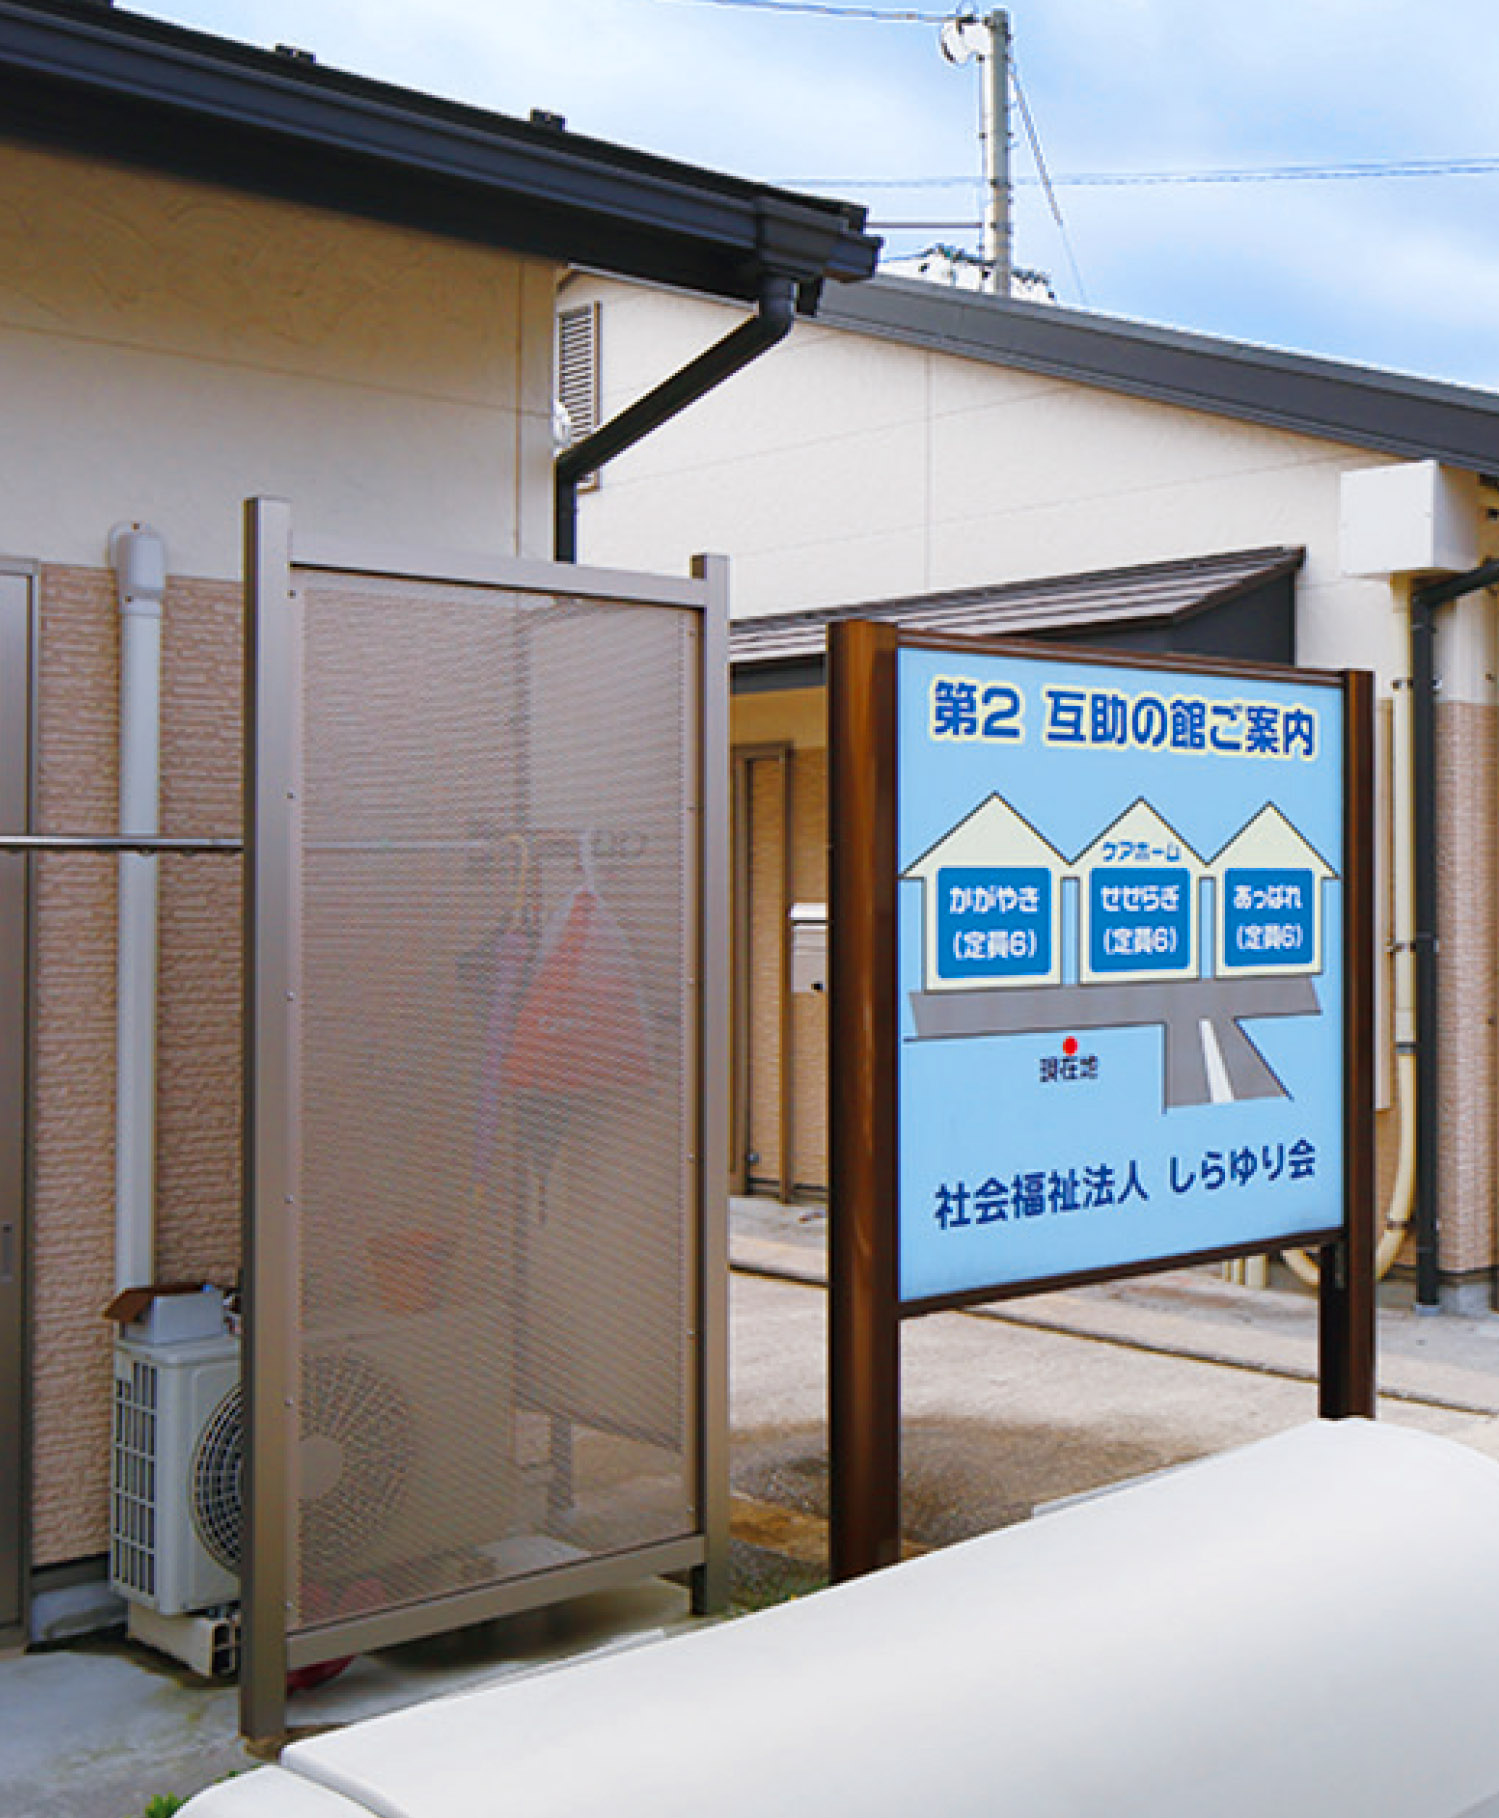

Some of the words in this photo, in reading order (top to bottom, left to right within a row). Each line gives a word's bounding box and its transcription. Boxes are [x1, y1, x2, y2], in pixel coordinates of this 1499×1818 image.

[934, 682, 1022, 739] 第2
[1045, 690, 1315, 756] 互助の館ご案内
[1102, 841, 1181, 862] ケアホーム
[949, 885, 1040, 913] かがやき
[1100, 885, 1180, 911] せせらぎ
[1039, 1056, 1099, 1082] 現在地
[934, 1160, 1149, 1230] 社会福祉法人
[1169, 1138, 1316, 1194] しらゆり会
